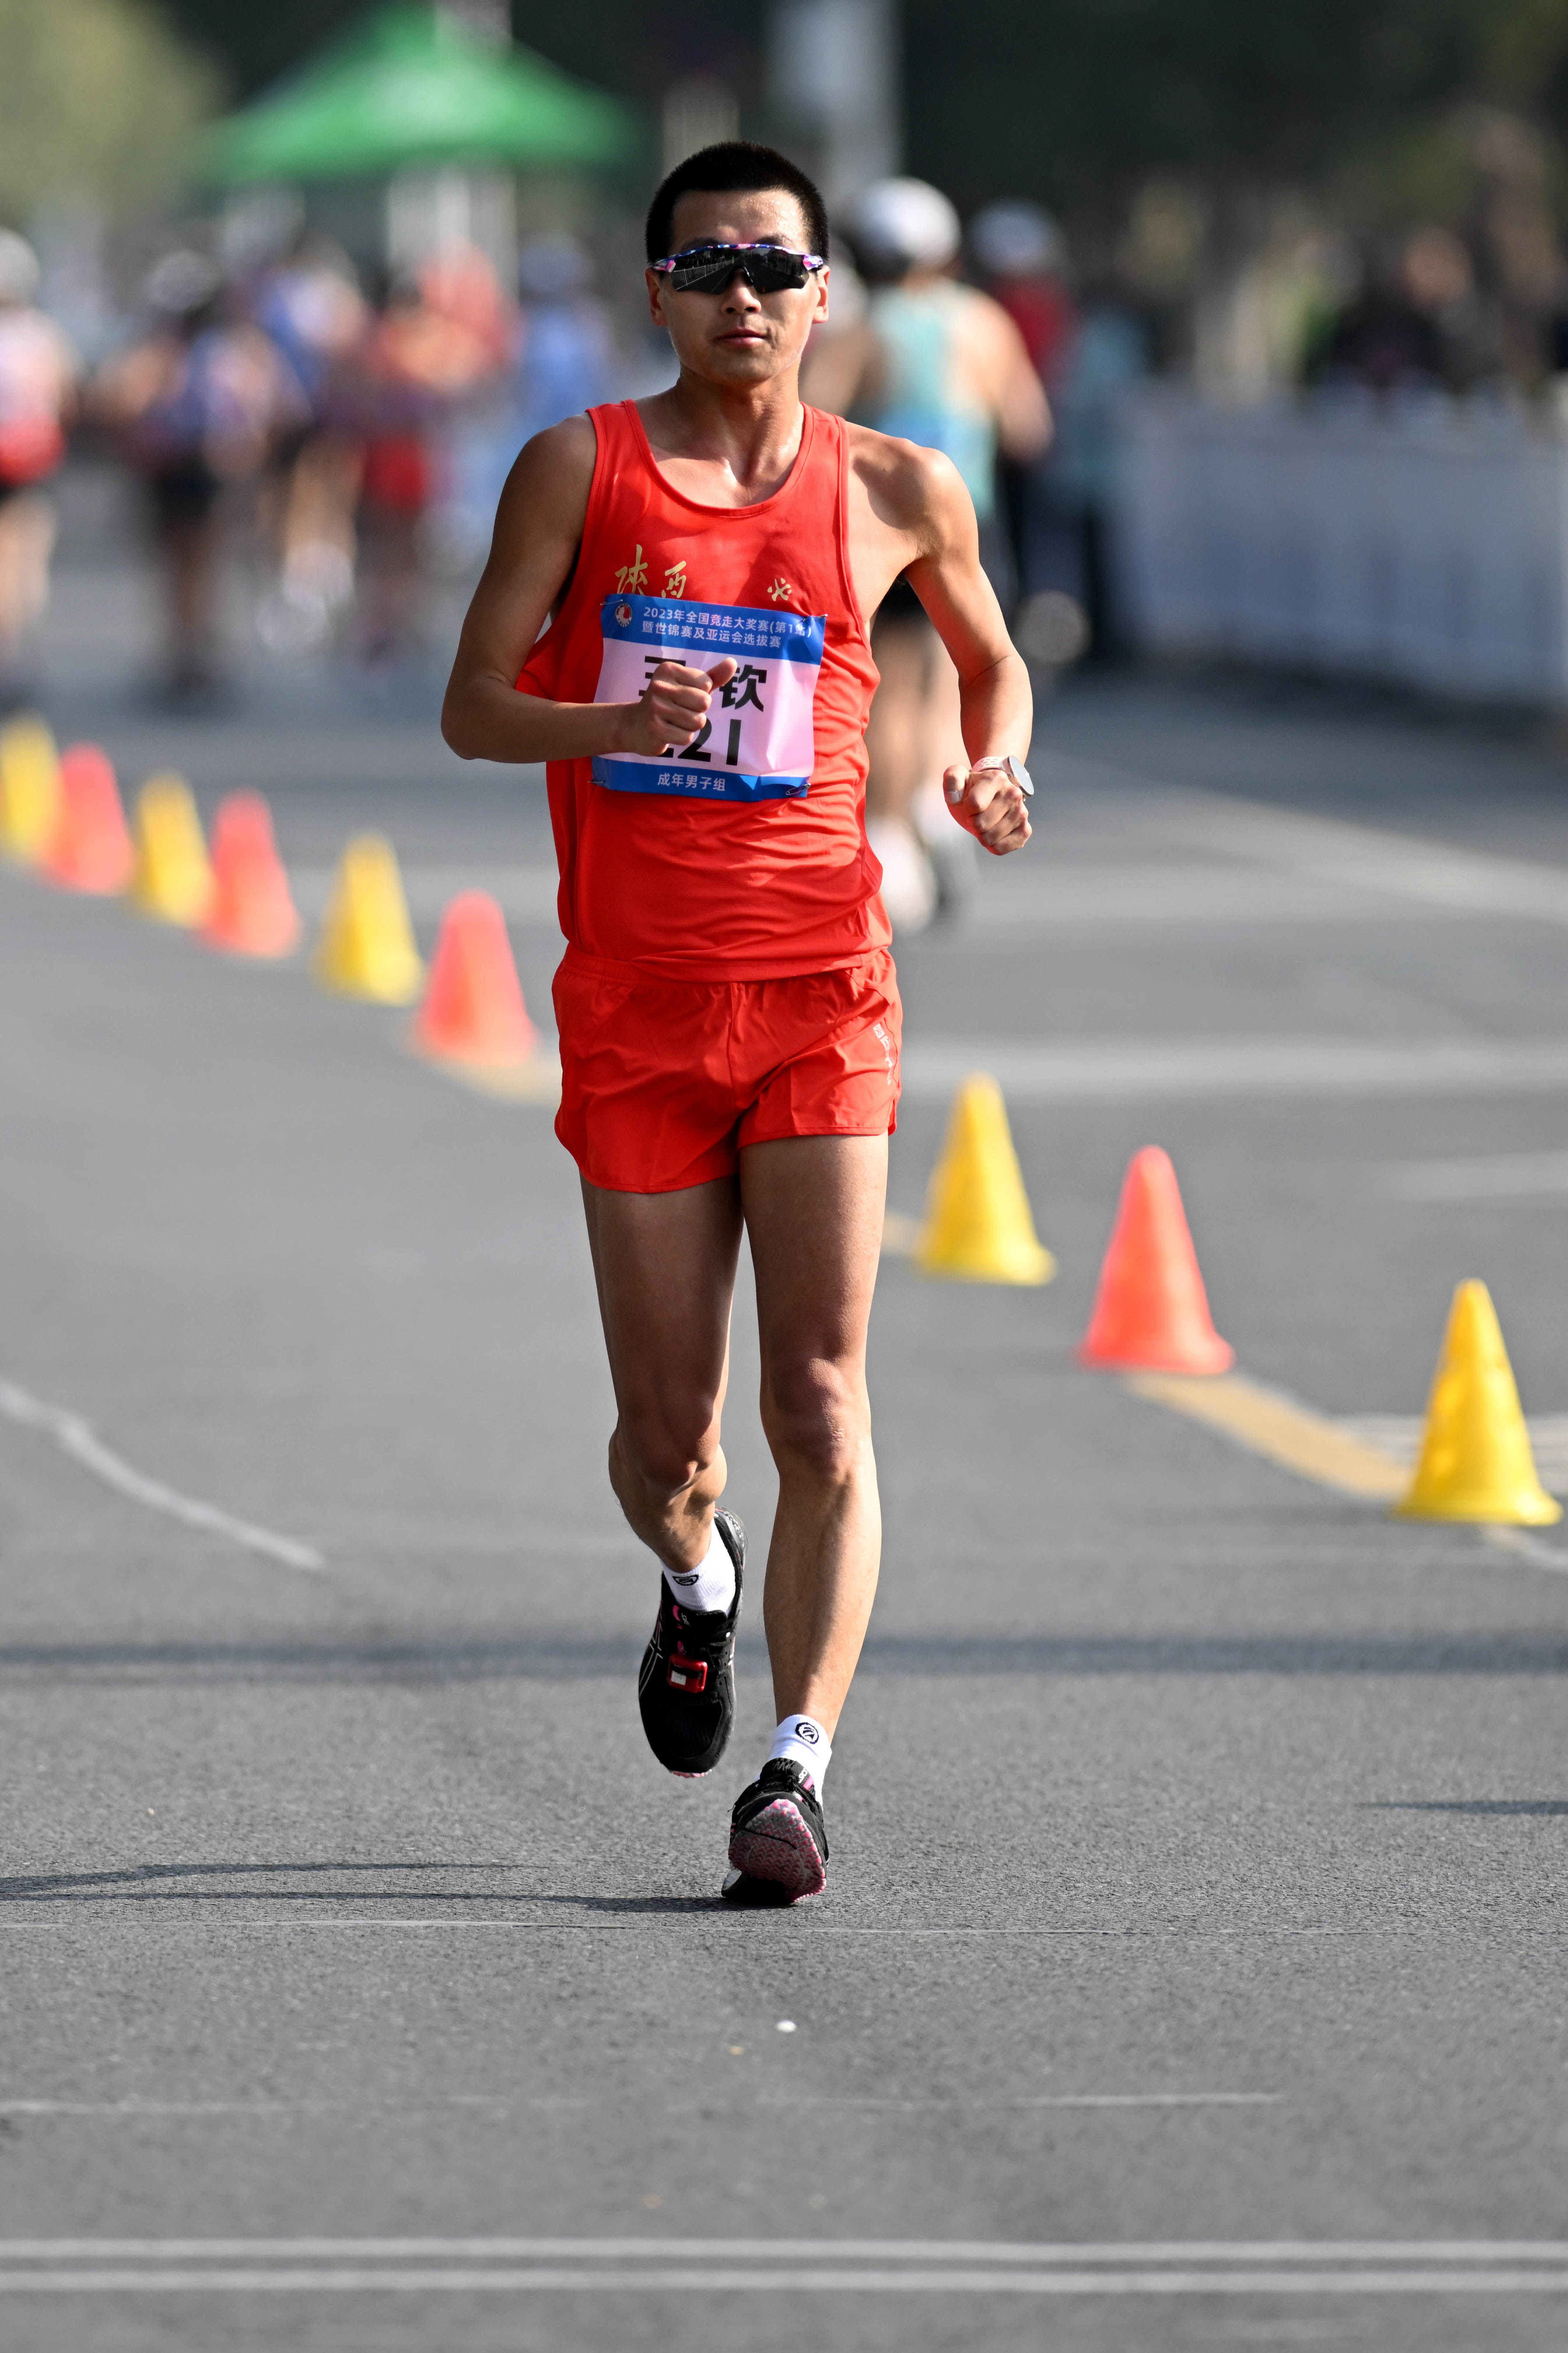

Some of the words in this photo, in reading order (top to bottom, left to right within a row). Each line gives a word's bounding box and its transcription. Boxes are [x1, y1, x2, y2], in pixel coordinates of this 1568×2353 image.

[615, 544, 687, 598] 陕西
[642, 620, 781, 648] 暨世锦赛及亚运会选拔赛
[659, 717, 742, 766] 21
[657, 772, 726, 791] 成年男子组
